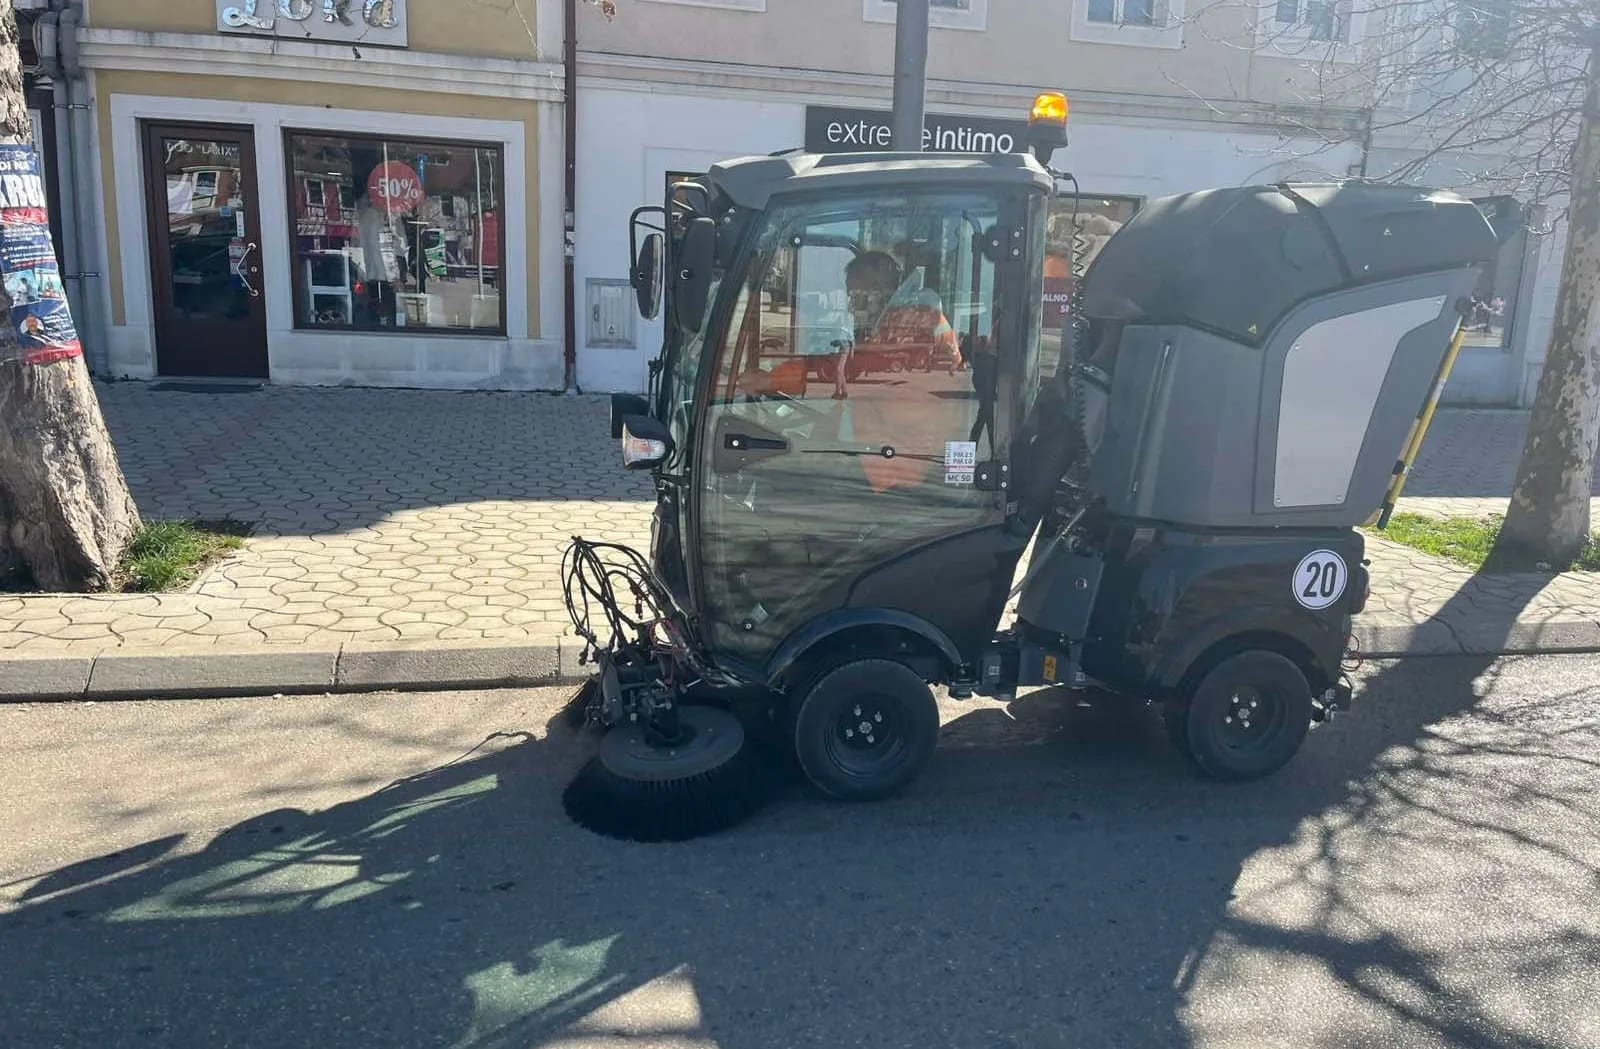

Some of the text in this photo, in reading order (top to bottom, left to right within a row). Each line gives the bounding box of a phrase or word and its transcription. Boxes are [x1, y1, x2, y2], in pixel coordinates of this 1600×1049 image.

[827, 120, 1014, 154] extree intimo
[1303, 561, 1338, 598] 20
